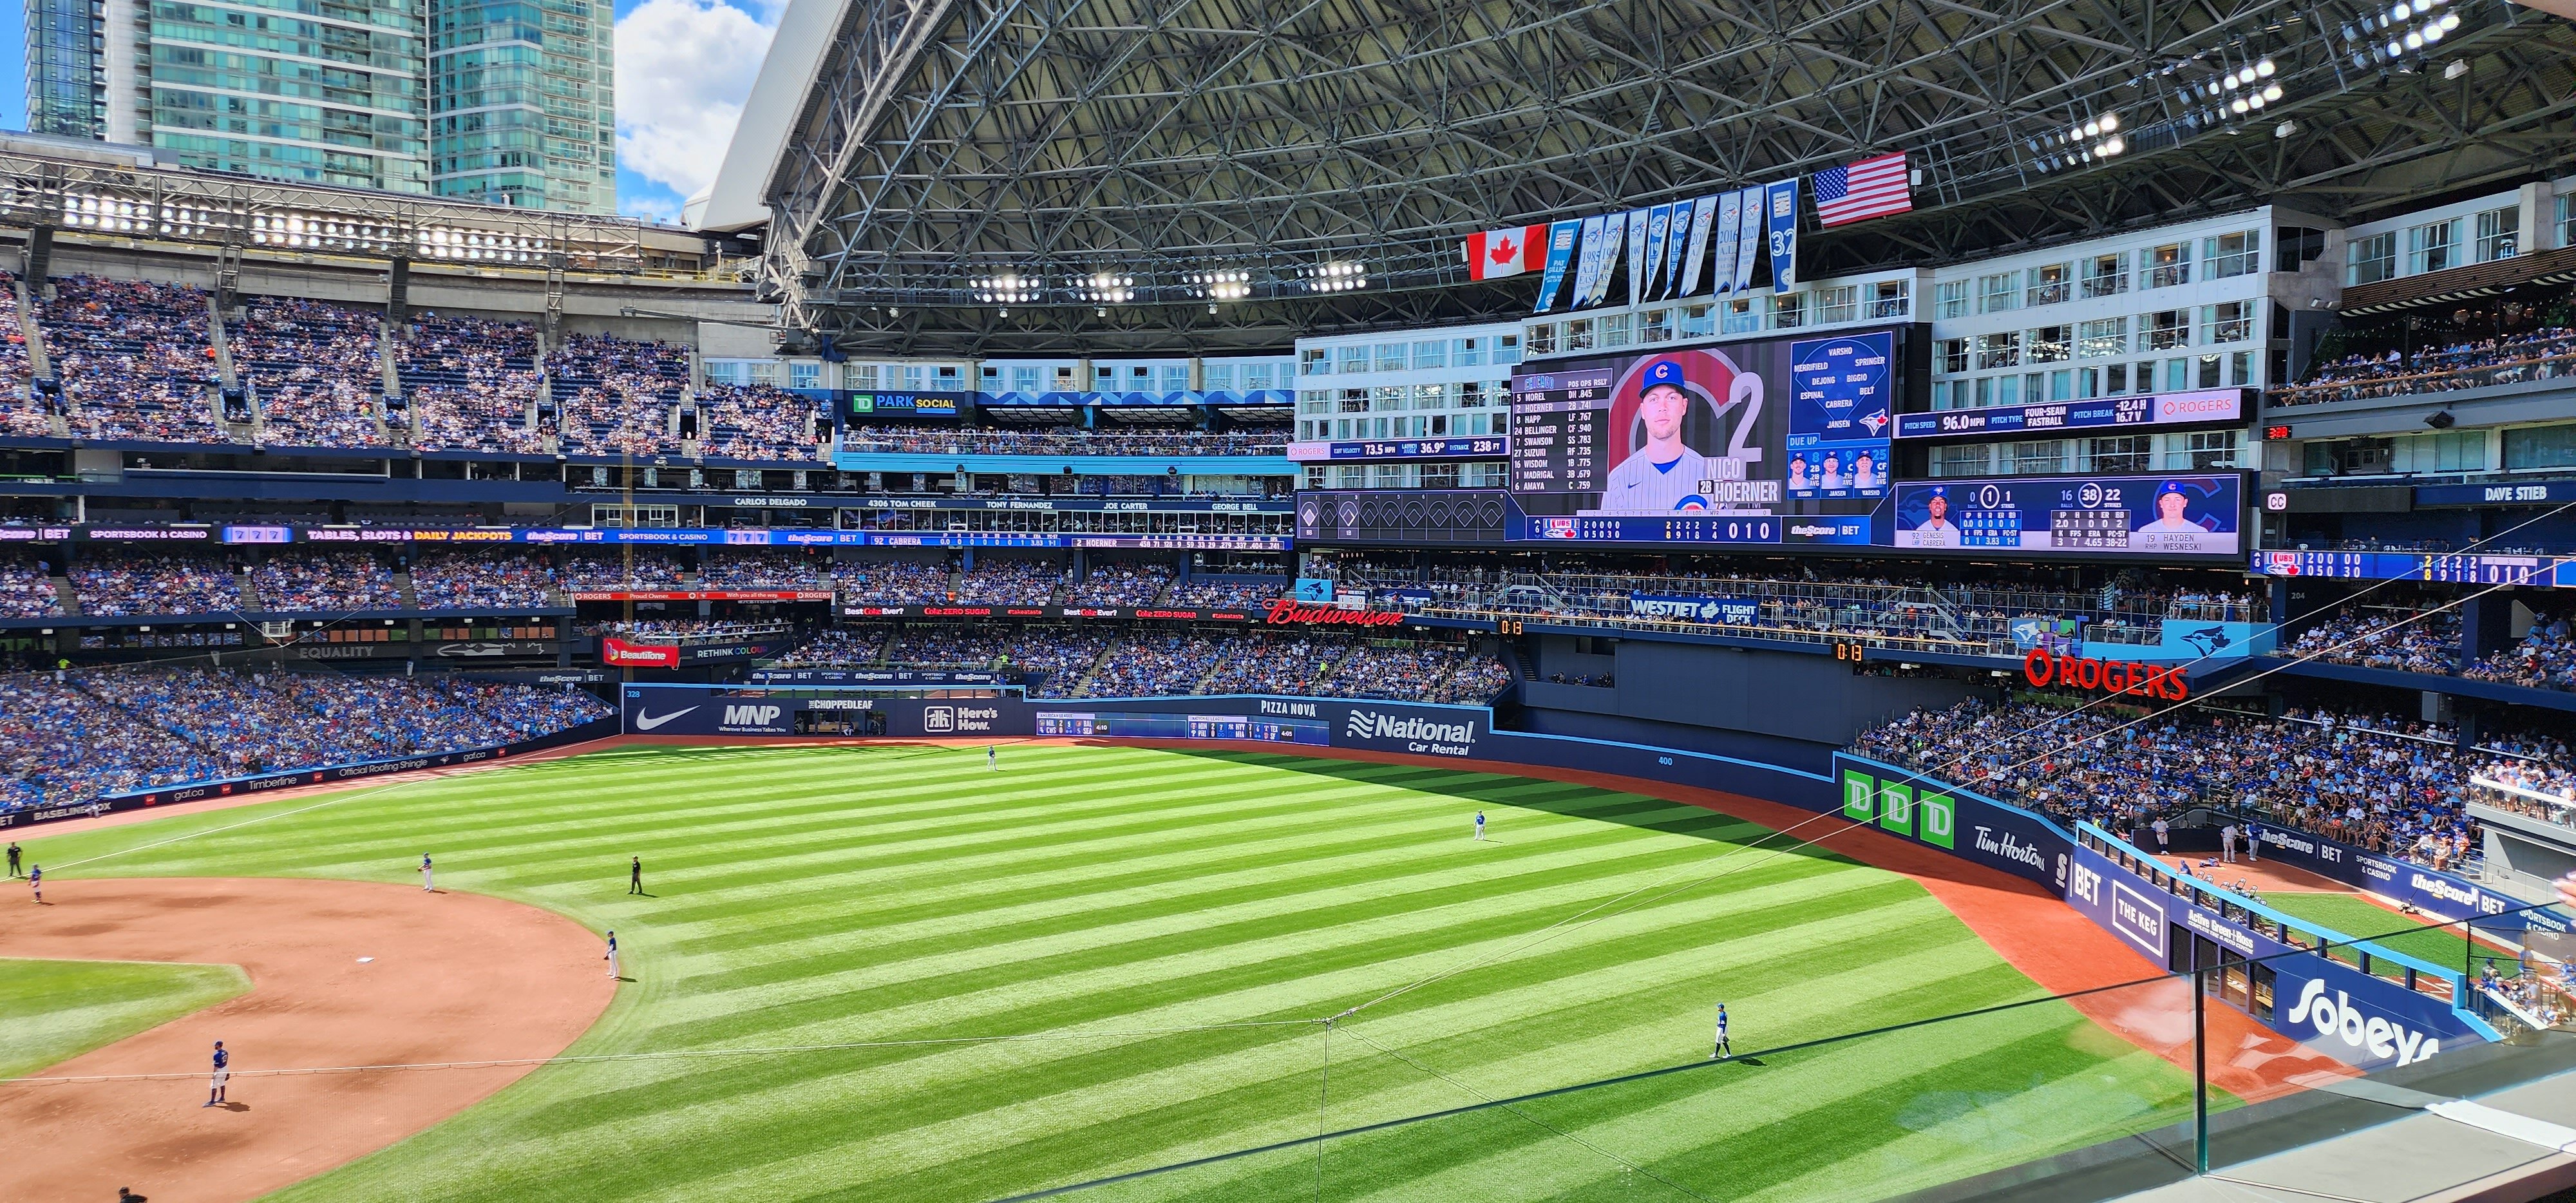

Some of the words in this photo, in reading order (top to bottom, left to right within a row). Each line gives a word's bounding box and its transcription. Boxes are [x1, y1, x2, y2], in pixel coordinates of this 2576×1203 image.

[1828, 346, 1852, 356] VARSHO
[1794, 362, 1828, 372] MERRIFIELD
[1855, 357, 1885, 366] SPRINGER
[1812, 375, 1835, 385] DEJONG
[1847, 374, 1867, 383] BIGGIO
[1801, 390, 1824, 399] ESPINAL
[1860, 386, 1874, 395] BELT
[1525, 393, 1546, 401] MOREL
[856, 397, 871, 411] TD
[876, 395, 914, 407] PARK
[916, 399, 956, 409] SOCIAL
[1525, 403, 1553, 412] HOERNER
[1826, 399, 1853, 408] CABRERA
[2179, 399, 2231, 413] ROGERS
[2025, 406, 2066, 417] FOUR-SEAM
[2074, 410, 2091, 419] PITCH
[2092, 408, 2114, 419] BREAK
[2116, 412, 2133, 422] 16.7
[1524, 415, 1541, 424] HAPP
[1827, 420, 1850, 429] JANSEN
[1919, 421, 1936, 429] SPEED
[1943, 415, 1969, 430] 96.0
[1970, 417, 1985, 427] MPH
[1991, 416, 2008, 424] PITCH
[2009, 415, 2023, 424] TYPE
[2028, 416, 2063, 426] FASTBALL
[1524, 426, 1557, 435] BELLINGER
[1473, 441, 1492, 451] 238
[1524, 437, 1553, 446] SWANSON
[1790, 437, 1804, 446] DUE
[1807, 437, 1817, 446] UP
[1365, 444, 1383, 455] 73.5
[1524, 449, 1546, 457] SUZUKI
[1524, 460, 1548, 468] WISDOM
[1707, 459, 1739, 479] NICO
[1524, 471, 1554, 479] MADRIGAL
[1700, 480, 1712, 493] 2B
[1714, 480, 1778, 502] HOERNER
[2485, 487, 2512, 501] DAVE
[2515, 486, 2547, 500] STIEB
[44, 529, 70, 539] BET
[307, 531, 359, 541] TABLES,
[361, 530, 401, 540] SLOTS
[402, 530, 412, 540] &
[414, 531, 449, 540] DAILY
[451, 531, 513, 540] JACKPOTS
[1792, 525, 1835, 536] theScore
[1842, 525, 1860, 535] BET
[526, 532, 578, 542] theScore
[584, 532, 604, 540] BET
[788, 534, 833, 544] theScore
[1262, 598, 1405, 626] Budweiser
[1722, 604, 1756, 615] FLIGHT
[299, 647, 374, 659] EQUALITY
[621, 650, 666, 660] BeautiTone
[697, 650, 734, 658] RETHINK
[735, 647, 767, 656] COLOUR
[2060, 654, 2189, 700] ROGERS
[958, 708, 998, 719] Here's
[1261, 700, 1287, 715] PIZZA
[1291, 703, 1316, 717] NOVA
[724, 705, 781, 725] MNP
[958, 721, 990, 730] How.
[1375, 715, 1474, 743] National
[1408, 742, 1428, 752] Car
[1431, 744, 1468, 756] Rental
[463, 751, 486, 762] gaf.ca
[1658, 757, 1672, 766] 400
[339, 766, 368, 778] Official
[369, 763, 398, 777] Roofing
[400, 759, 428, 772] Shingle
[249, 776, 297, 790] Timberline
[174, 788, 204, 802] gaf.ca
[1847, 779, 1870, 812] TD
[1884, 789, 1909, 824] TD
[33, 807, 86, 821] BASELINE
[1924, 800, 1951, 836] TD
[1974, 826, 1999, 855] Tim
[2000, 834, 2046, 873] Hortons
[2322, 848, 2342, 863] BET
[2356, 855, 2397, 874] SPORTSBOOK
[2368, 867, 2391, 881] CASINO
[2074, 863, 2101, 906] BET
[2412, 873, 2471, 905] theScore
[2482, 890, 2505, 914] BET
[2118, 899, 2137, 924] THE
[2138, 911, 2158, 936] KEG
[2188, 909, 2210, 928] Active
[2289, 978, 2439, 1067] Sobeys
